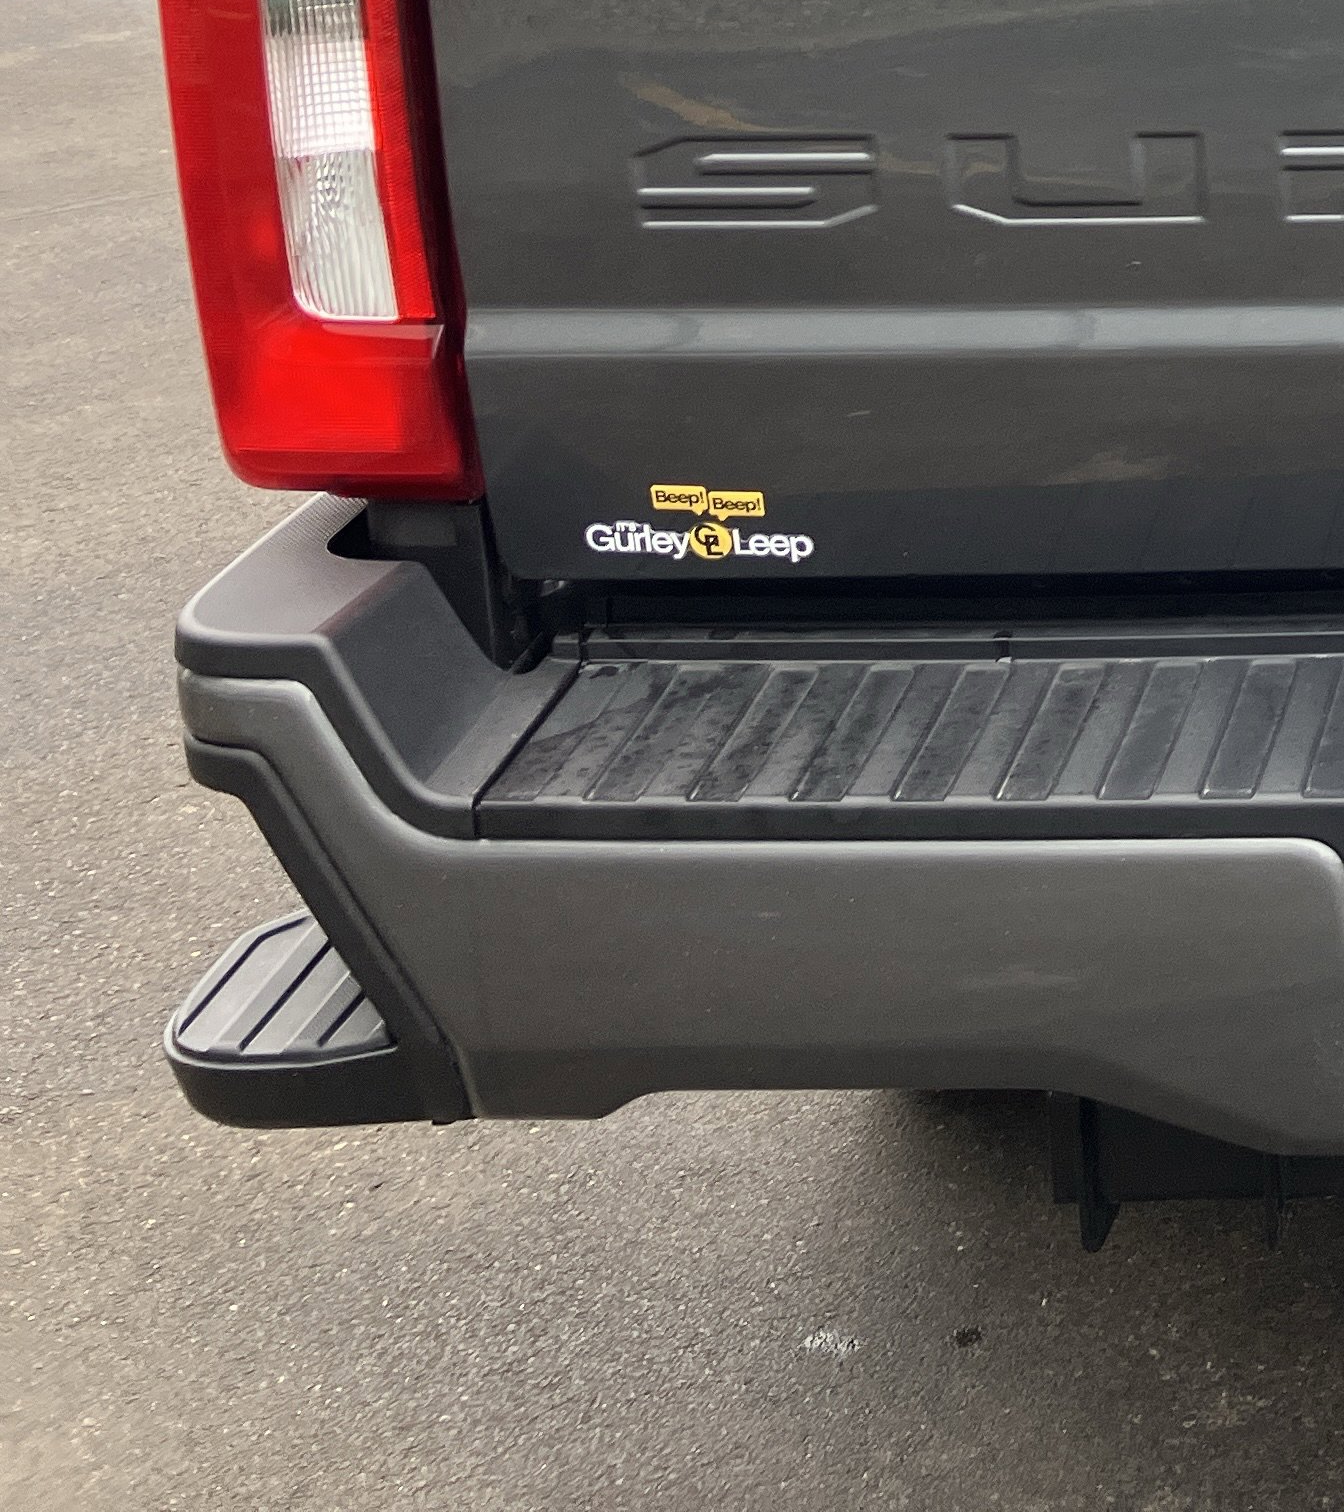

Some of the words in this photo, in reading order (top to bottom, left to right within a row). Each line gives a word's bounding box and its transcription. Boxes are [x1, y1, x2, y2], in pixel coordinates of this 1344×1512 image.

[655, 490, 704, 507] Beep!
[713, 497, 762, 513] Beep!
[586, 523, 690, 560] Gurley
[732, 528, 815, 564] Leep
